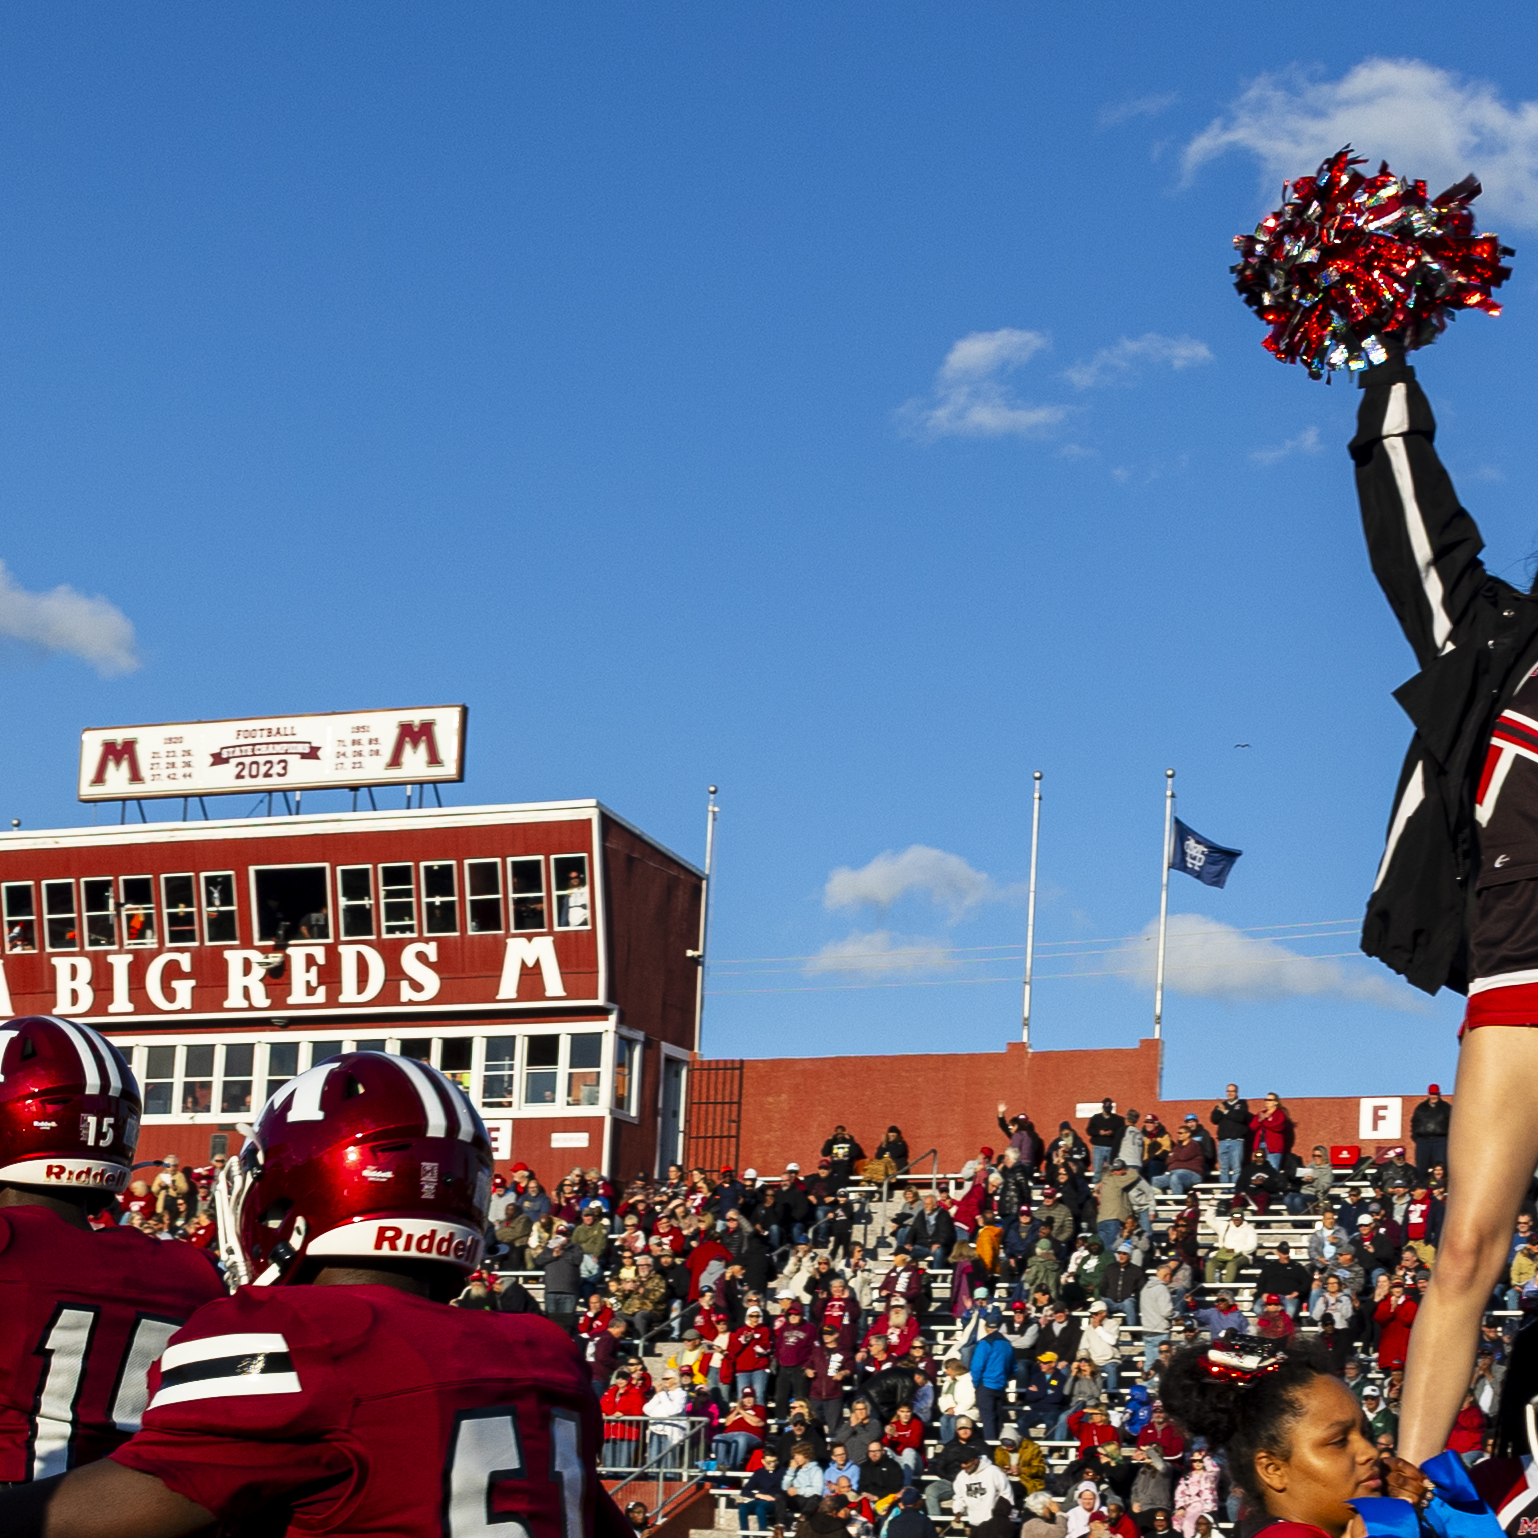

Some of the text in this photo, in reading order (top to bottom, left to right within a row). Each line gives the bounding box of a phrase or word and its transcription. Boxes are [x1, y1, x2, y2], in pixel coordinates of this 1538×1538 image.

[235, 726, 297, 740] FOOTBALL
[384, 719, 445, 770] M
[89, 738, 145, 786] M
[234, 759, 289, 779] 2023
[52, 952, 197, 1015] BIG
[223, 941, 442, 1008] REDS
[496, 935, 567, 1000] M
[87, 1115, 115, 1148] 15
[1372, 1105, 1388, 1132] F
[45, 1164, 128, 1188] Riddell
[373, 1224, 485, 1263] Riddell
